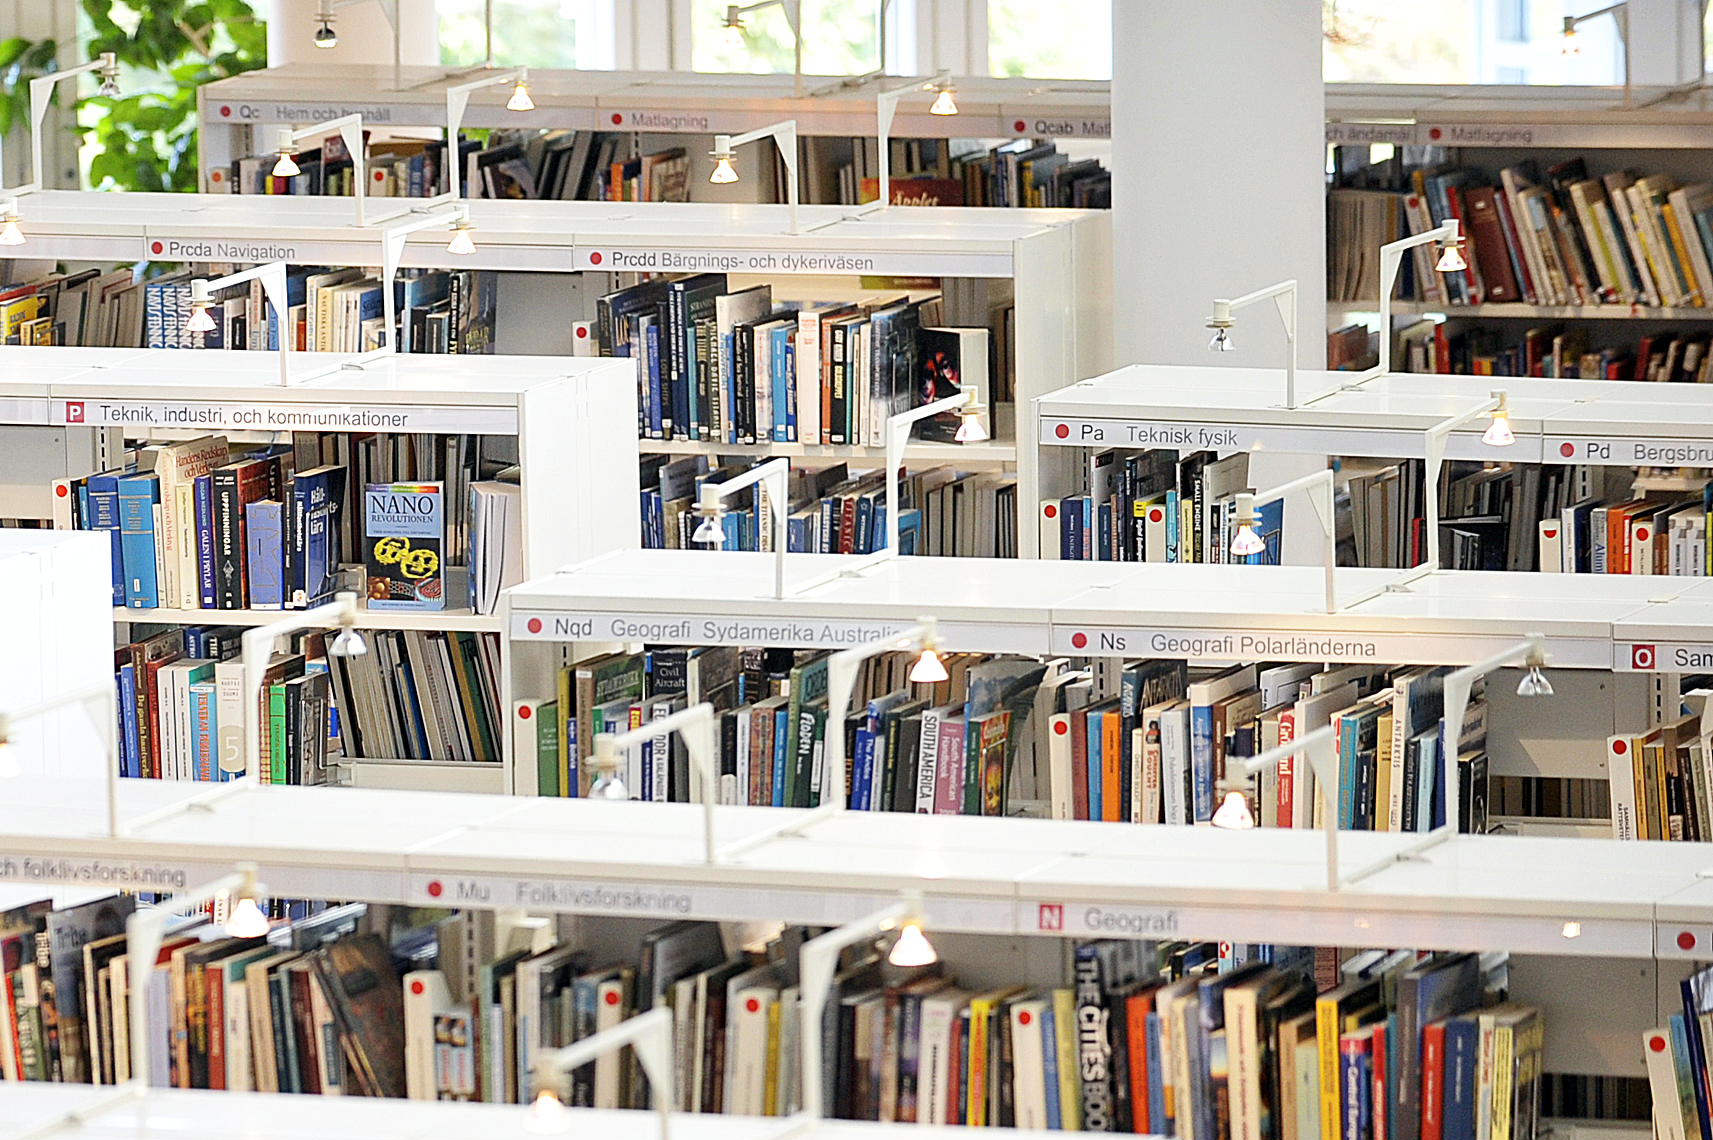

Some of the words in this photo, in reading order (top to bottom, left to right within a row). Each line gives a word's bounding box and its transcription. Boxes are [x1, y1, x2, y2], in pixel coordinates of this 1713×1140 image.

[239, 105, 260, 121] Qc
[276, 106, 306, 120] Hem
[1034, 119, 1074, 136] Qcab
[169, 242, 212, 257] Prcda
[217, 243, 295, 261] Navigation
[612, 252, 656, 267] Prcdd
[661, 253, 744, 270] Bärgnings-
[749, 255, 777, 269] och
[781, 254, 873, 272] dykeriväsen
[68, 404, 81, 420] P
[100, 405, 158, 423] Teknik,
[164, 407, 227, 424] industri,
[232, 411, 262, 424] och
[268, 409, 408, 427] kommunikationer
[1081, 424, 1104, 441] Pa
[1127, 426, 1193, 444] Teknisk
[1198, 428, 1238, 448] fysik
[1587, 443, 1610, 460] Pd
[1634, 444, 1713, 464] Bergsbru
[371, 495, 433, 515] NANO
[222, 492, 231, 555] UPPFINNINGAR
[371, 515, 433, 523] REVOLUTIONEN
[843, 501, 853, 546] TITANIC
[201, 529, 210, 553] GALEN
[555, 619, 593, 638] Nqd
[610, 620, 690, 641] Geografi
[703, 622, 814, 644] Sydamerika
[1100, 632, 1126, 650] Ns
[1151, 634, 1233, 656] Geografi
[1241, 637, 1376, 656] Polarländerna
[1635, 648, 1652, 667] O
[1675, 649, 1713, 667] Sam
[654, 677, 685, 688] Aircraft
[659, 667, 679, 678] Civil
[923, 715, 937, 750] SOUTH
[1393, 719, 1402, 768] ANTARKTIS
[225, 736, 240, 762] 5
[865, 739, 874, 752] The
[951, 737, 960, 761] South
[863, 755, 873, 779] Andes
[919, 752, 935, 799] AMERICA
[949, 762, 958, 800] American
[23, 859, 186, 889] folklivsforskning
[1042, 906, 1060, 929] N
[1084, 909, 1178, 933] Geografi
[1077, 957, 1099, 1006] THE
[1080, 1005, 1108, 1083] CITIES
